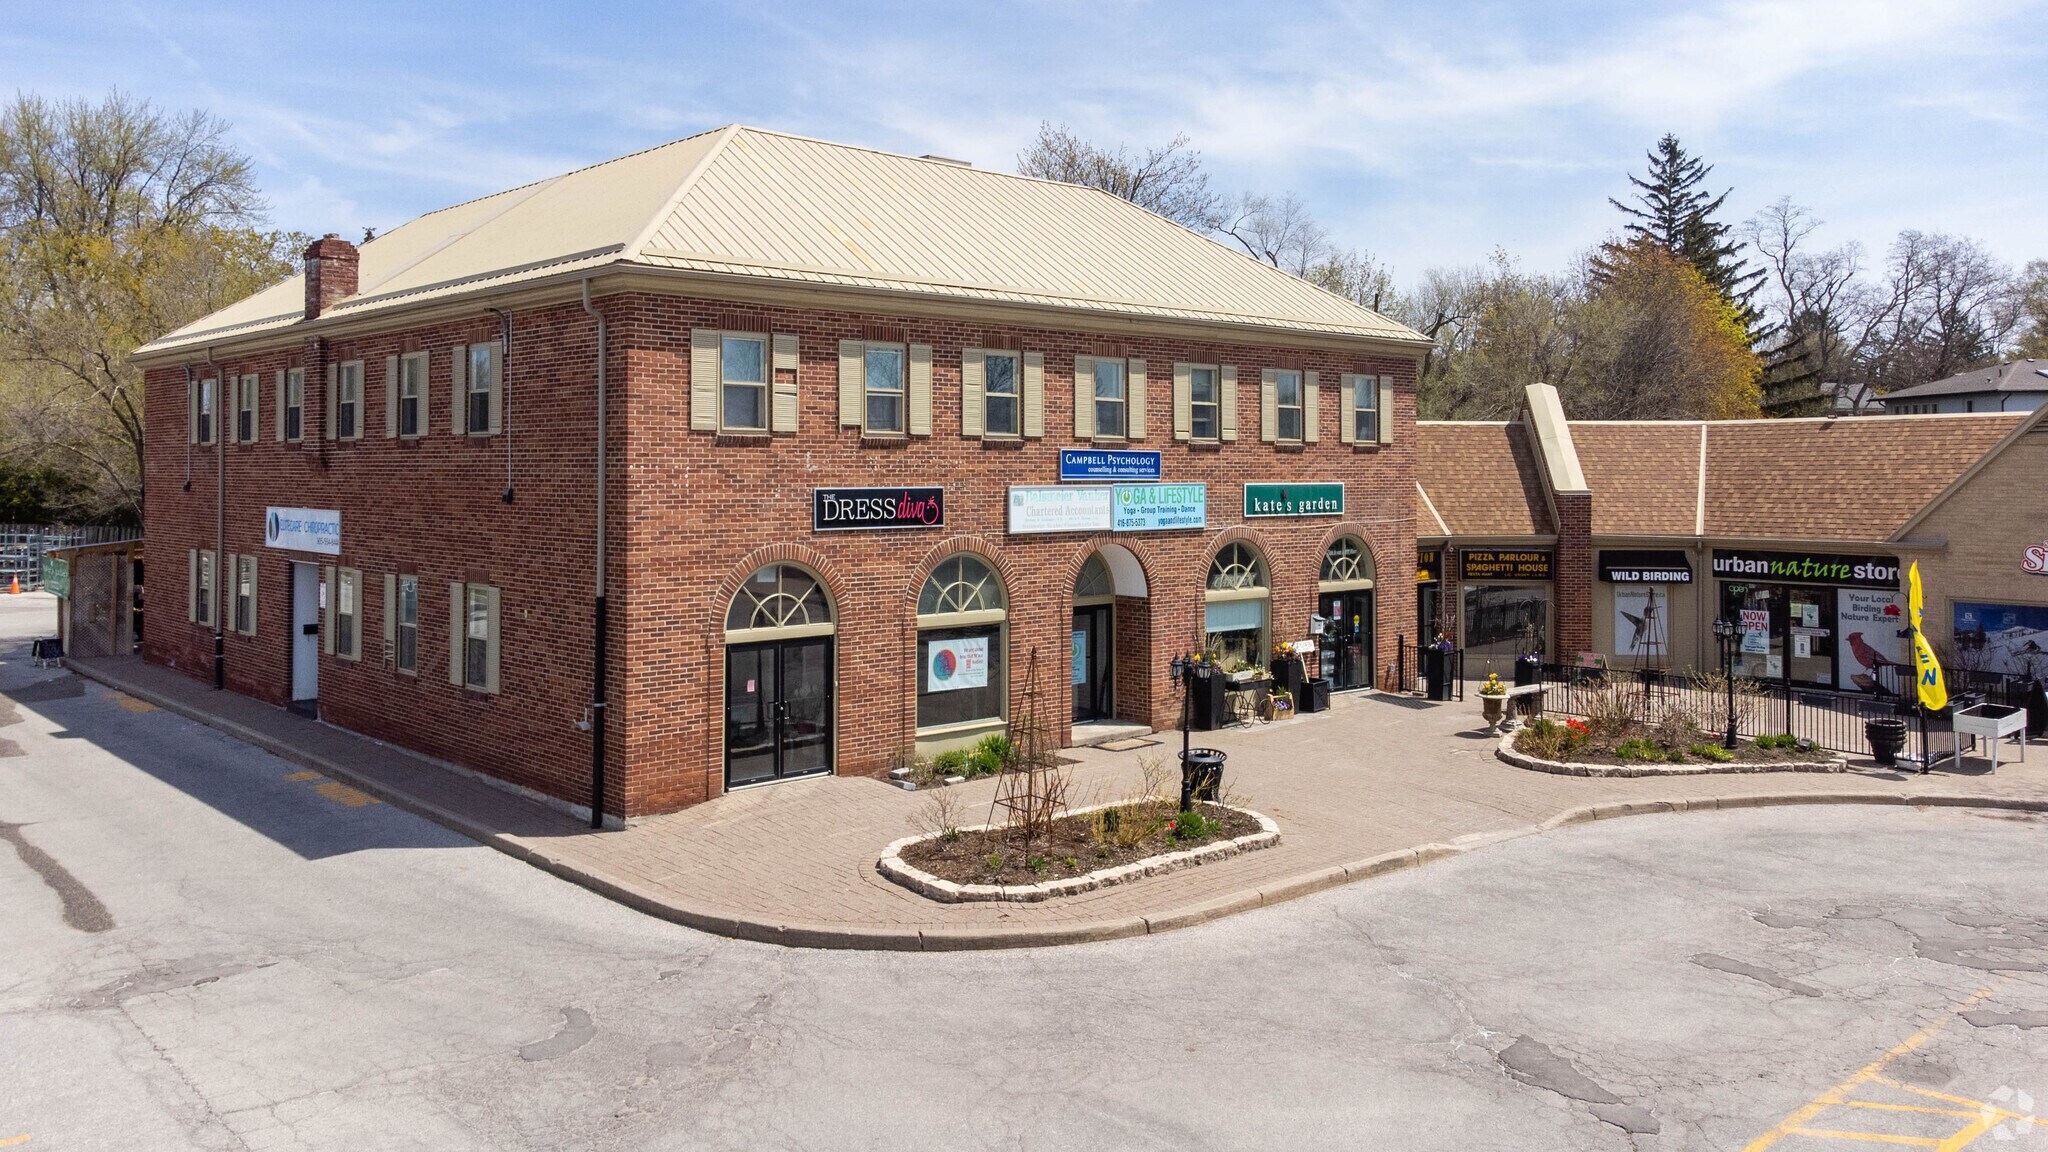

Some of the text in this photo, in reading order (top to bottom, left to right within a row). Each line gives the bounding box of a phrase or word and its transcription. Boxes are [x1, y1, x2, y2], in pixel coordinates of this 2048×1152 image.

[1065, 453, 1155, 466] CAMPBELL PSYCHOLOGY
[1115, 486, 1204, 505] YOGA & LIFESTYLE
[823, 498, 897, 521] DRESS
[897, 491, 933, 523] diva
[1123, 505, 1196, 515] Yoga Group Training Dance
[1298, 497, 1338, 513] garden
[1026, 504, 1110, 517] Chartered Accountants
[1469, 553, 1494, 561] PIZZA
[1499, 553, 1540, 562] PARLOUR
[1466, 563, 1549, 572] SPAGHETTI HOUSE
[1713, 556, 1769, 574] urban
[1770, 557, 1852, 580] nature
[1611, 571, 1690, 581] WILD BIRDING
[1729, 585, 1749, 596] open
[1849, 594, 1894, 603] Your Local
[1852, 604, 1882, 614] Birding
[1742, 611, 1767, 621] NOW
[1840, 612, 1869, 621] Nature
